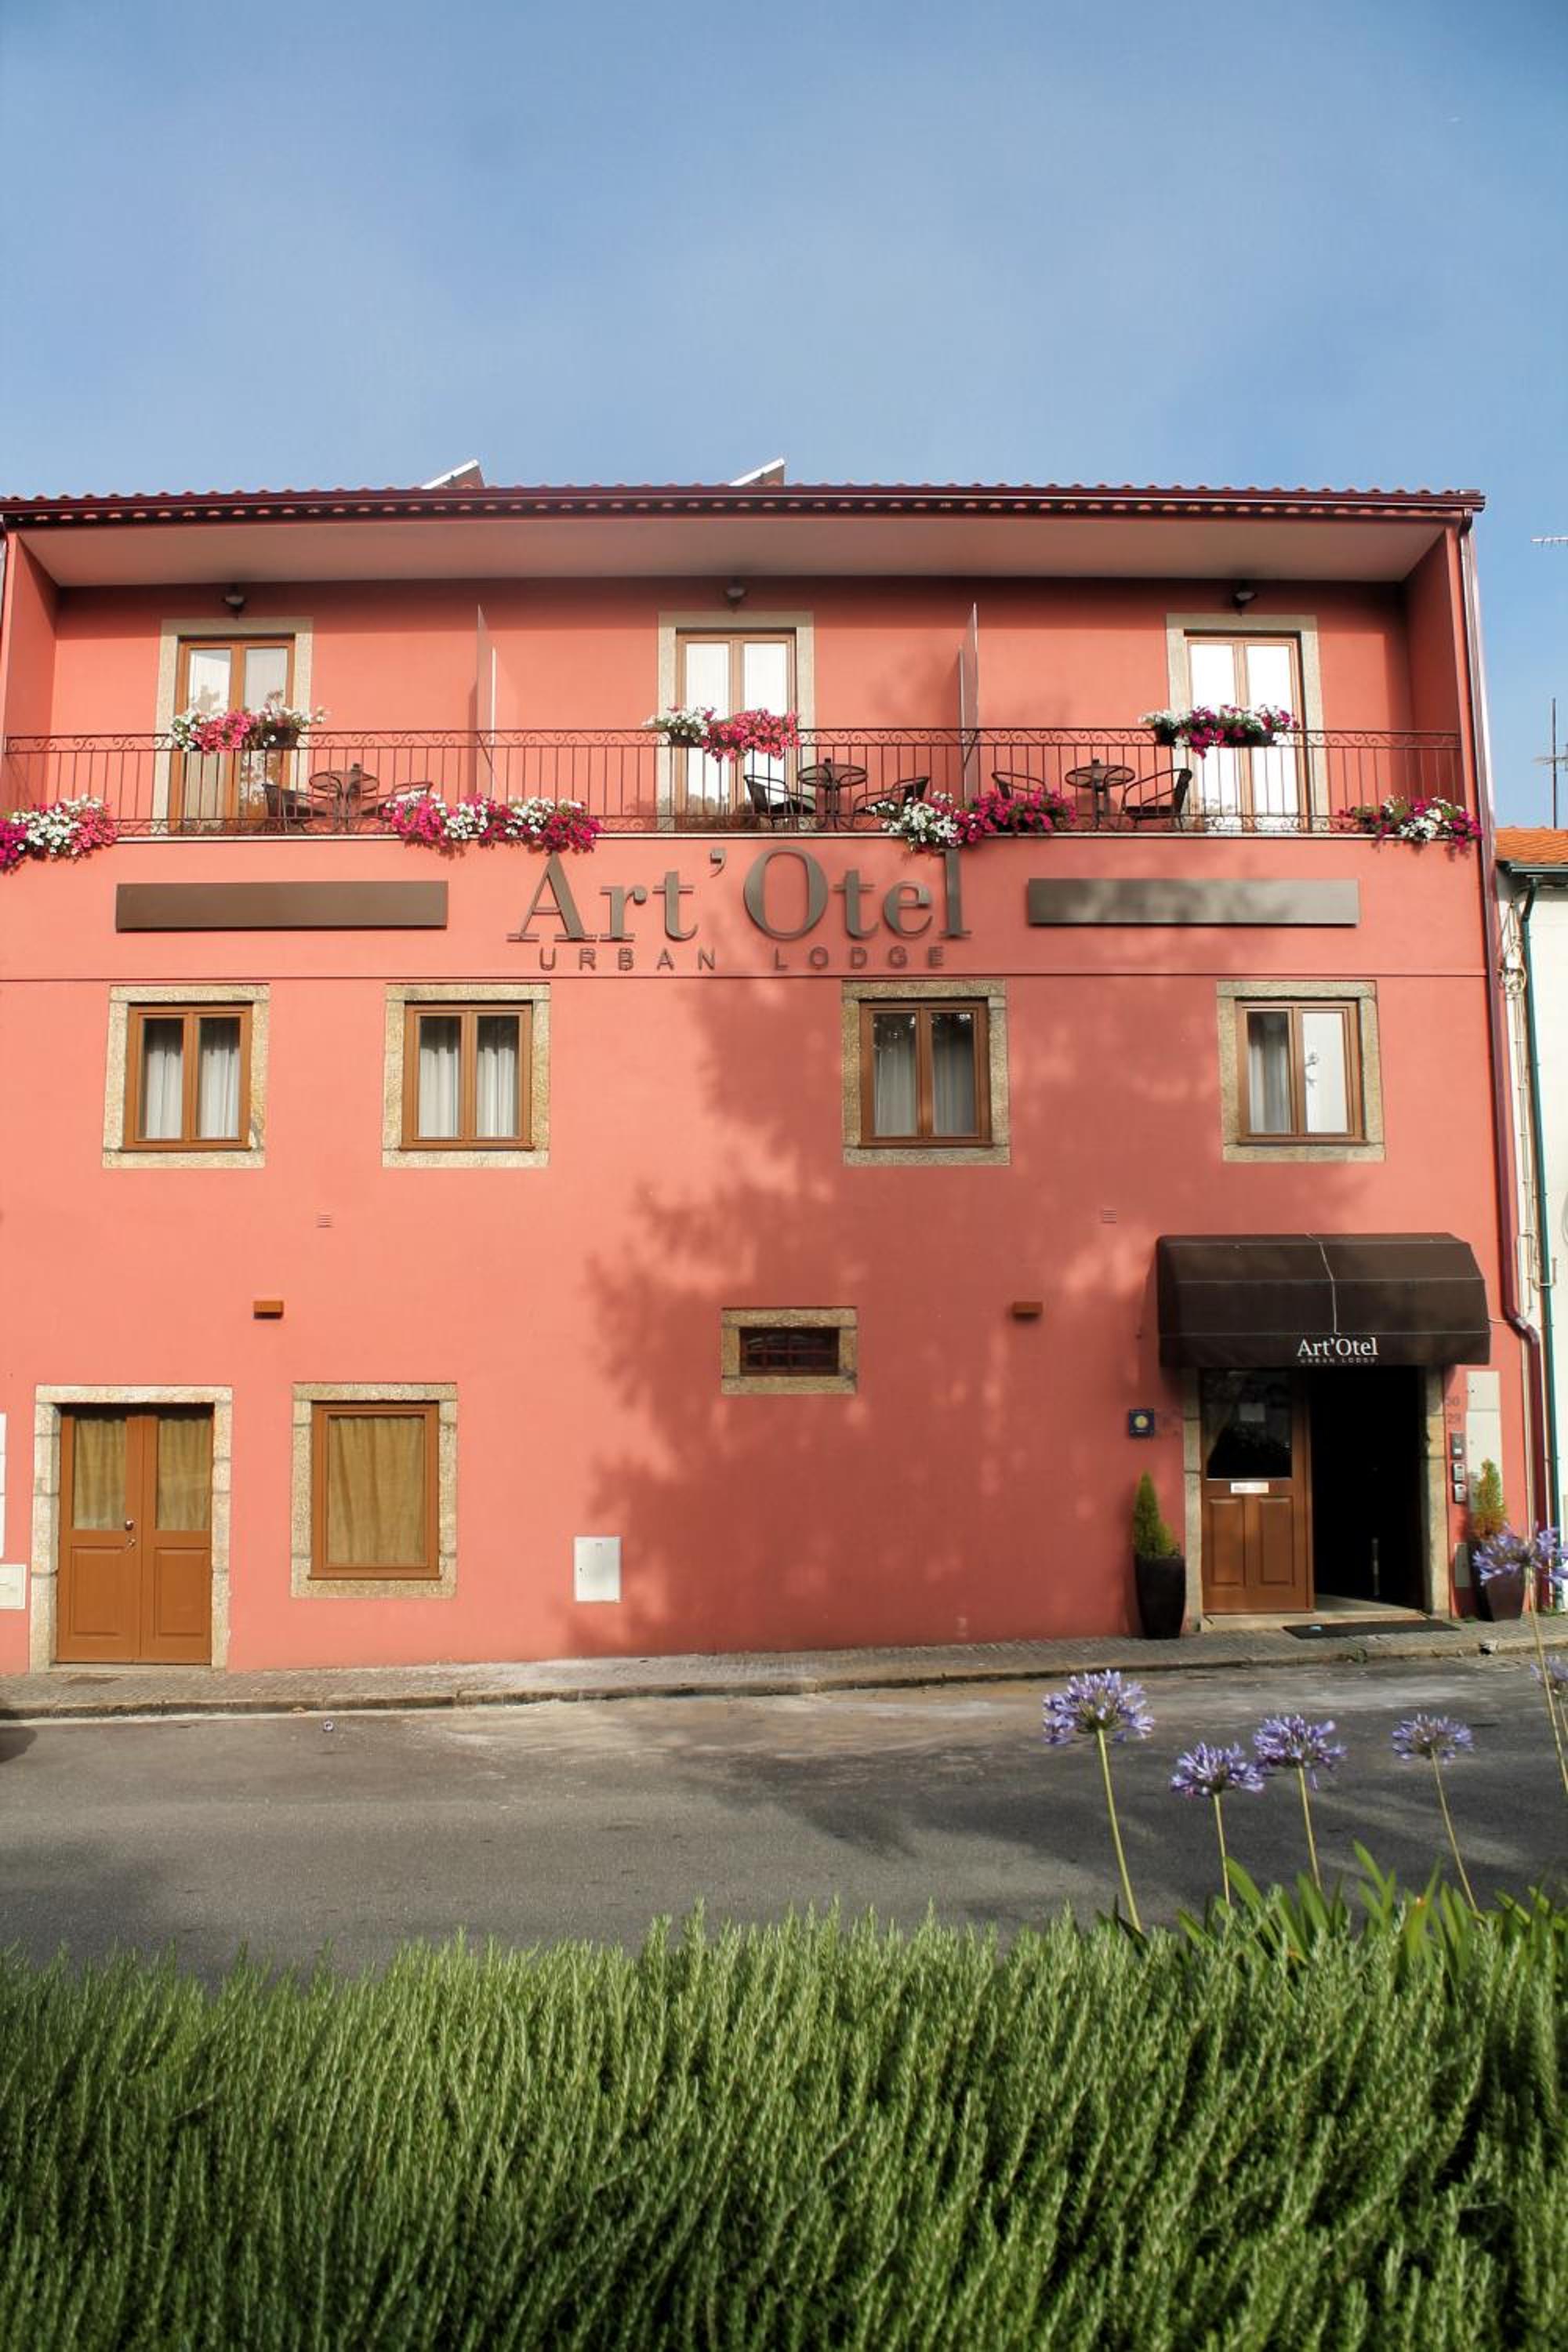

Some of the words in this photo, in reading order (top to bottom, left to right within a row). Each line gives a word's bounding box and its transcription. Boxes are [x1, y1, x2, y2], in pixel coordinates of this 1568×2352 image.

[539, 946, 716, 971] URBAN
[774, 946, 945, 970] LODGE
[1296, 1337, 1379, 1357] Art'Otel
